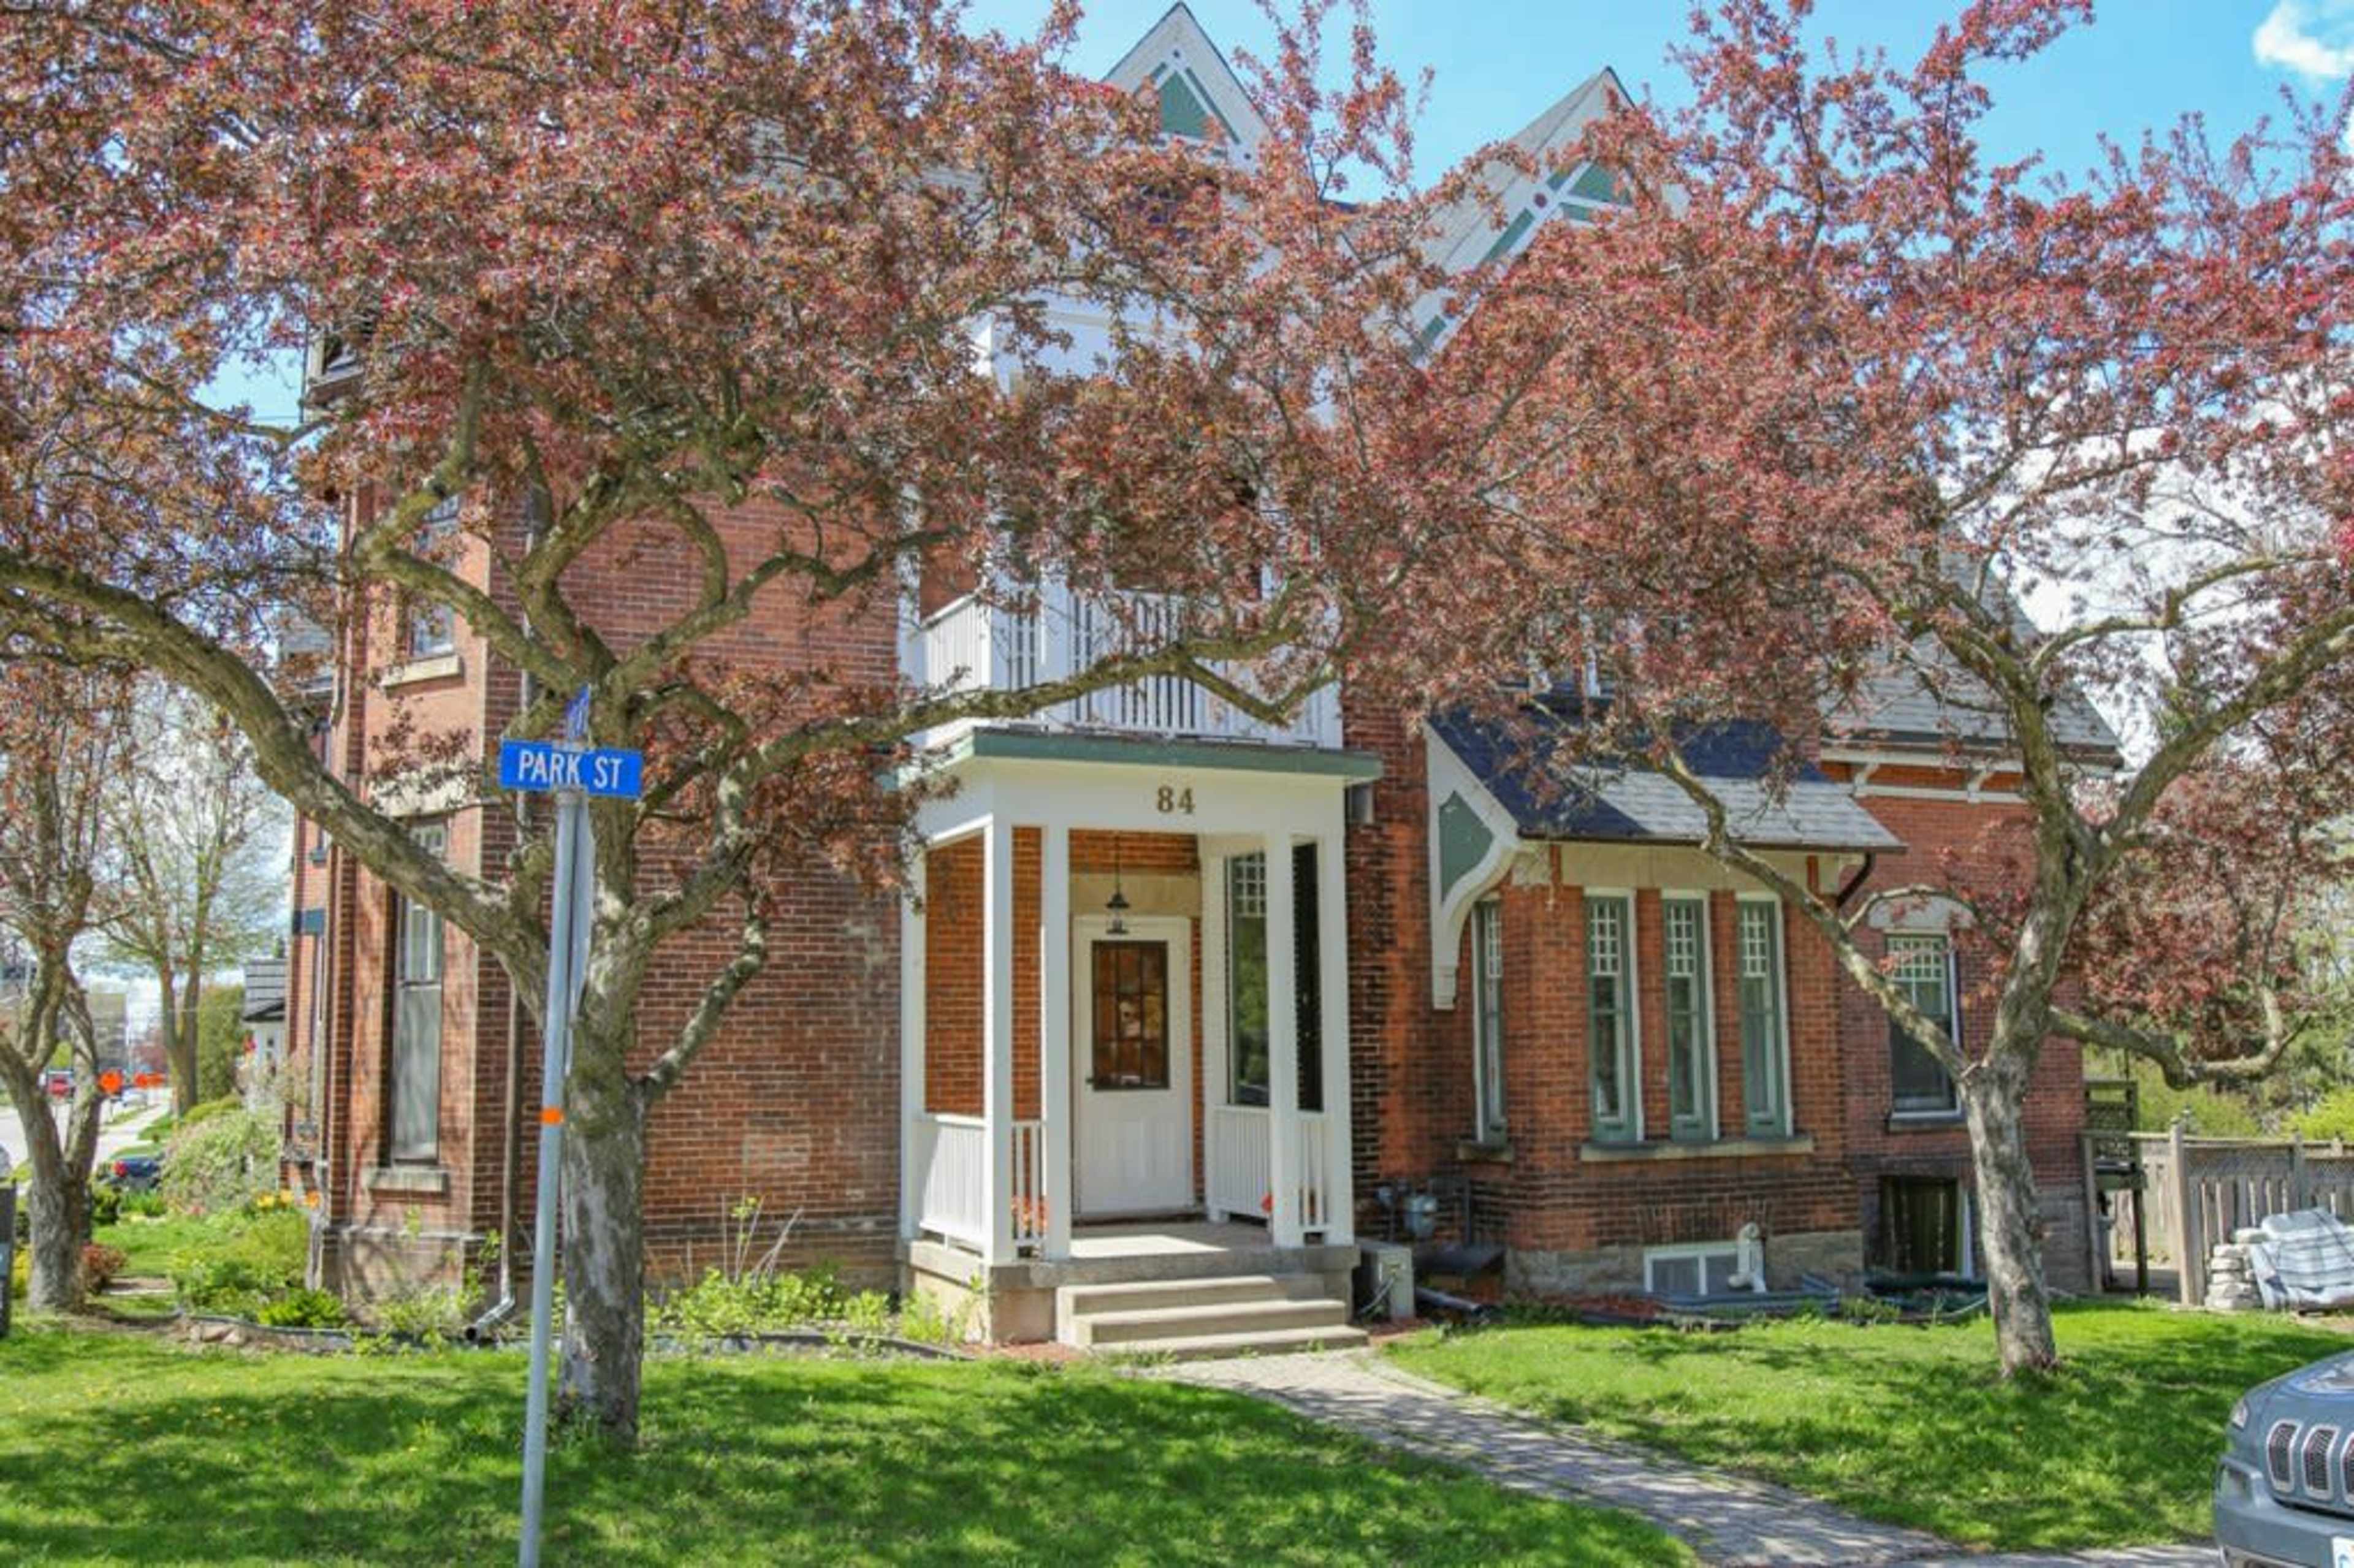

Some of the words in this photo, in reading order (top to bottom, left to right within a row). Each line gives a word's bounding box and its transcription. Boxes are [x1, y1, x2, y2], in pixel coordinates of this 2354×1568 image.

[517, 748, 582, 785] PARK
[593, 756, 623, 790] ST
[1157, 785, 1196, 814] 84
